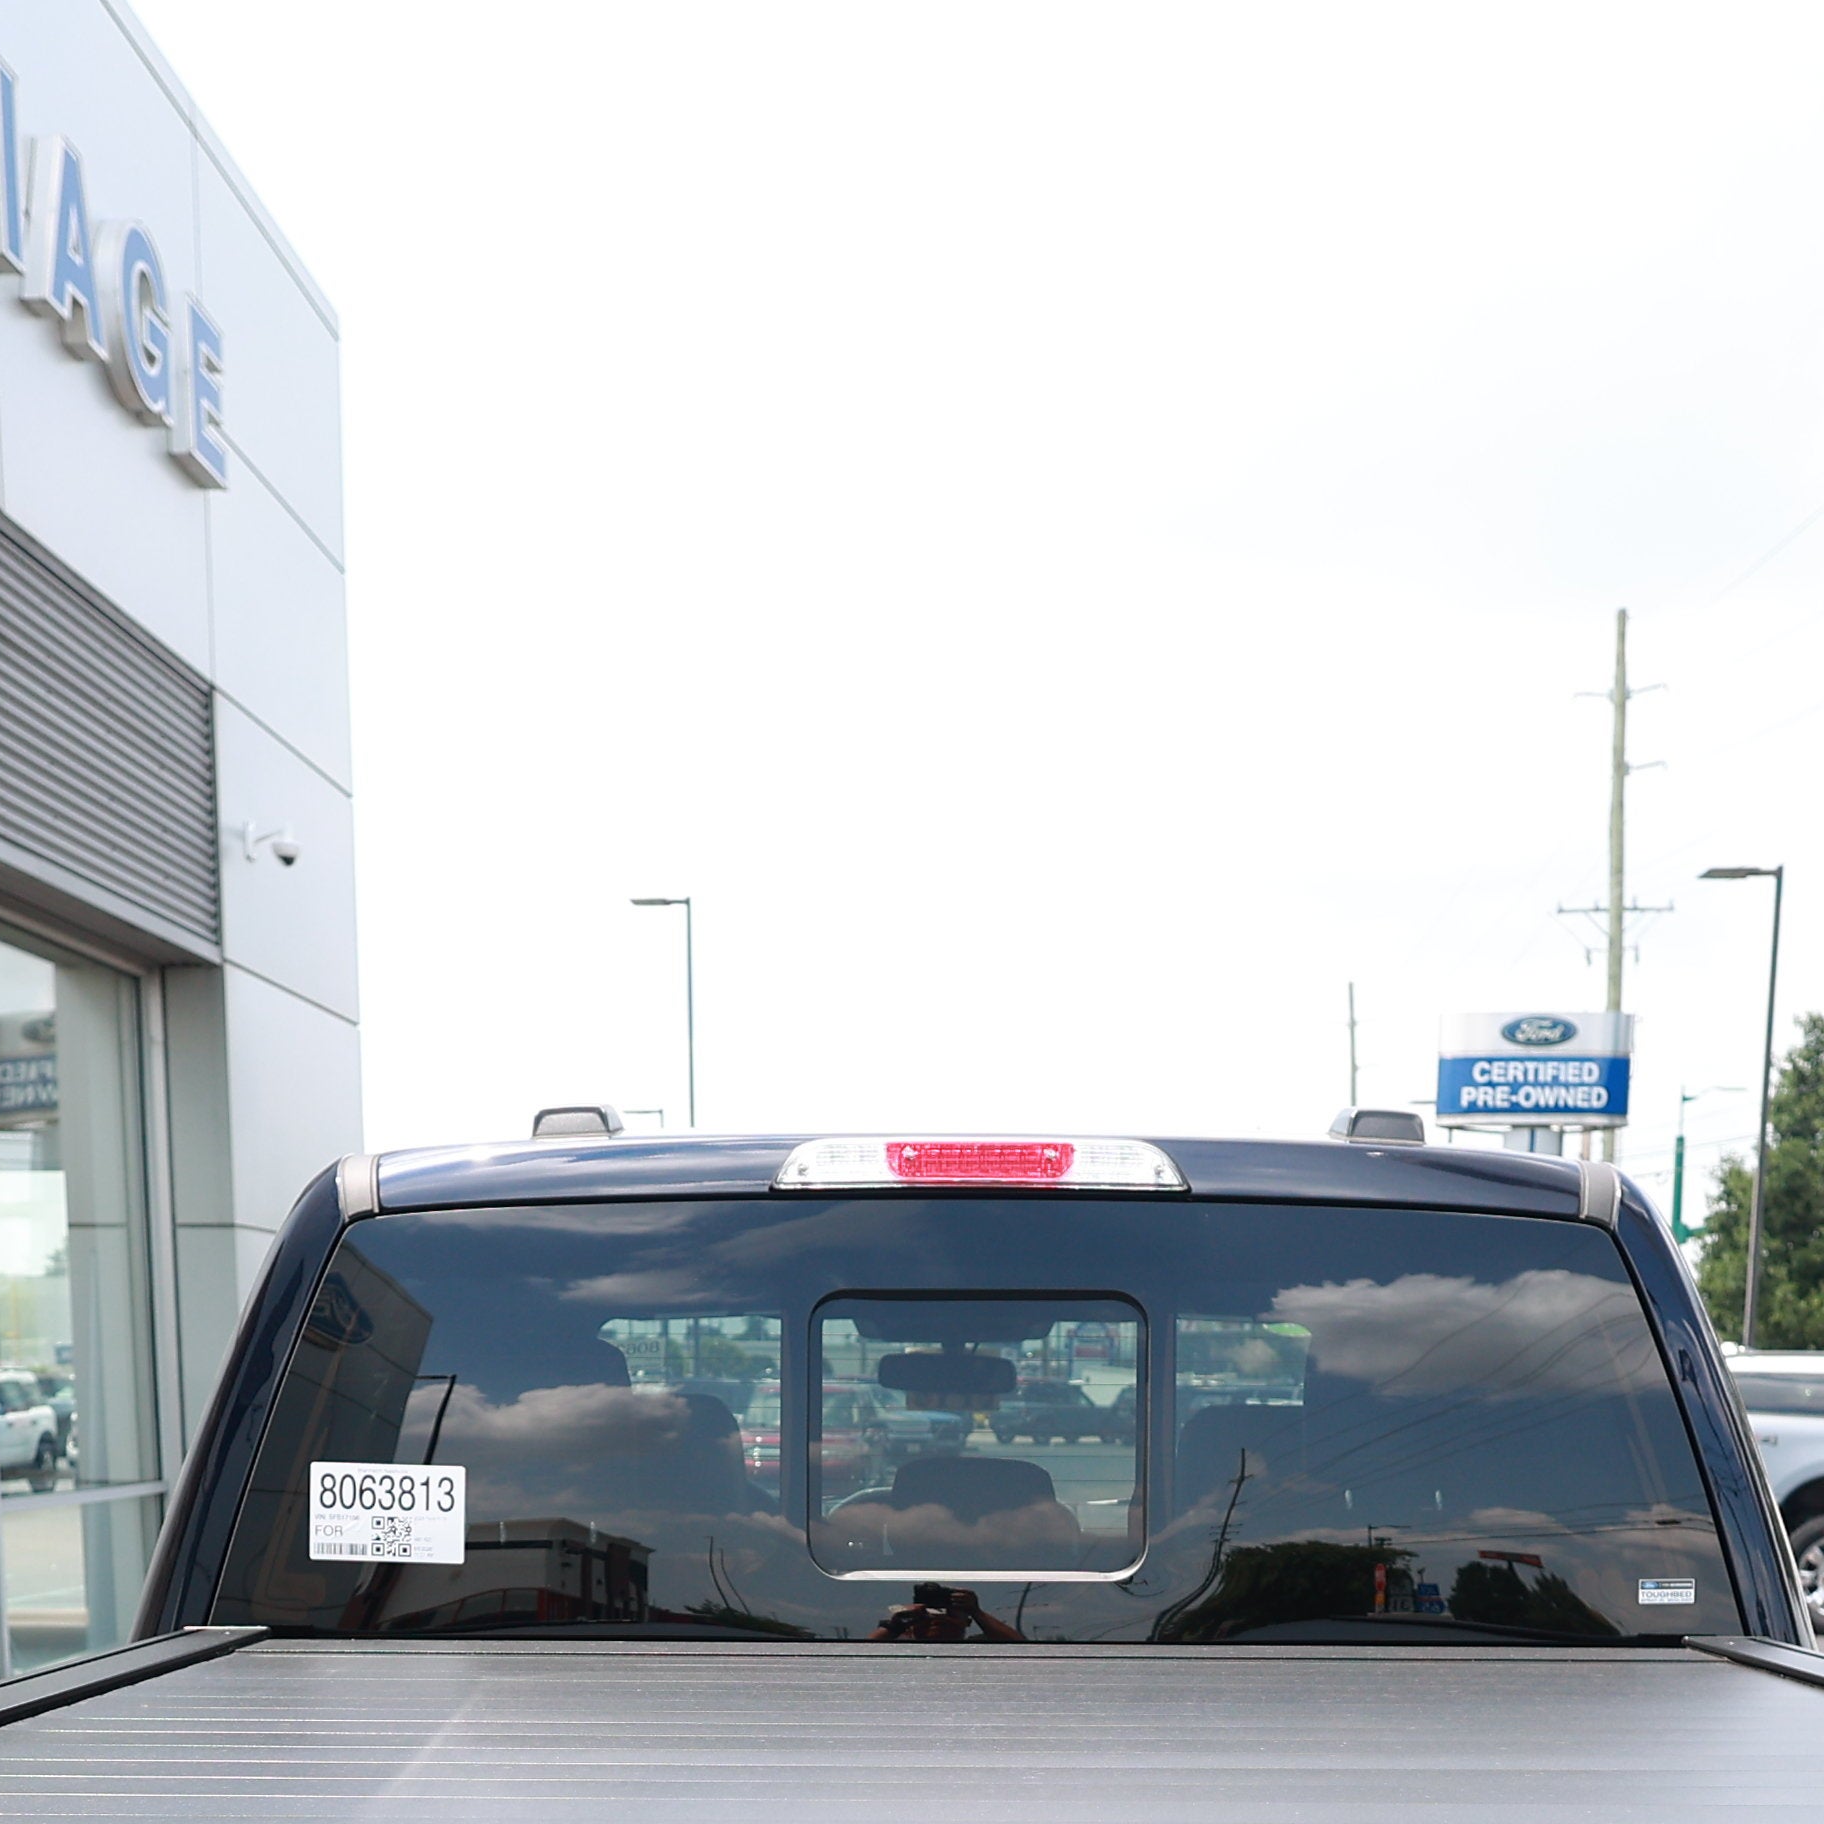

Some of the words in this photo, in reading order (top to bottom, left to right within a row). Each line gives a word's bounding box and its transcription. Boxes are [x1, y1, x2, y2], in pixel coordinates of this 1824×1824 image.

[1513, 1018, 1566, 1042] Ford
[1472, 1060, 1599, 1084] CERTIFIED
[1460, 1085, 1608, 1109] PRE-OWNED
[319, 1473, 455, 1513] 8063813
[315, 1524, 344, 1538] FOR
[1641, 1590, 1692, 1598] TOUGHBED
